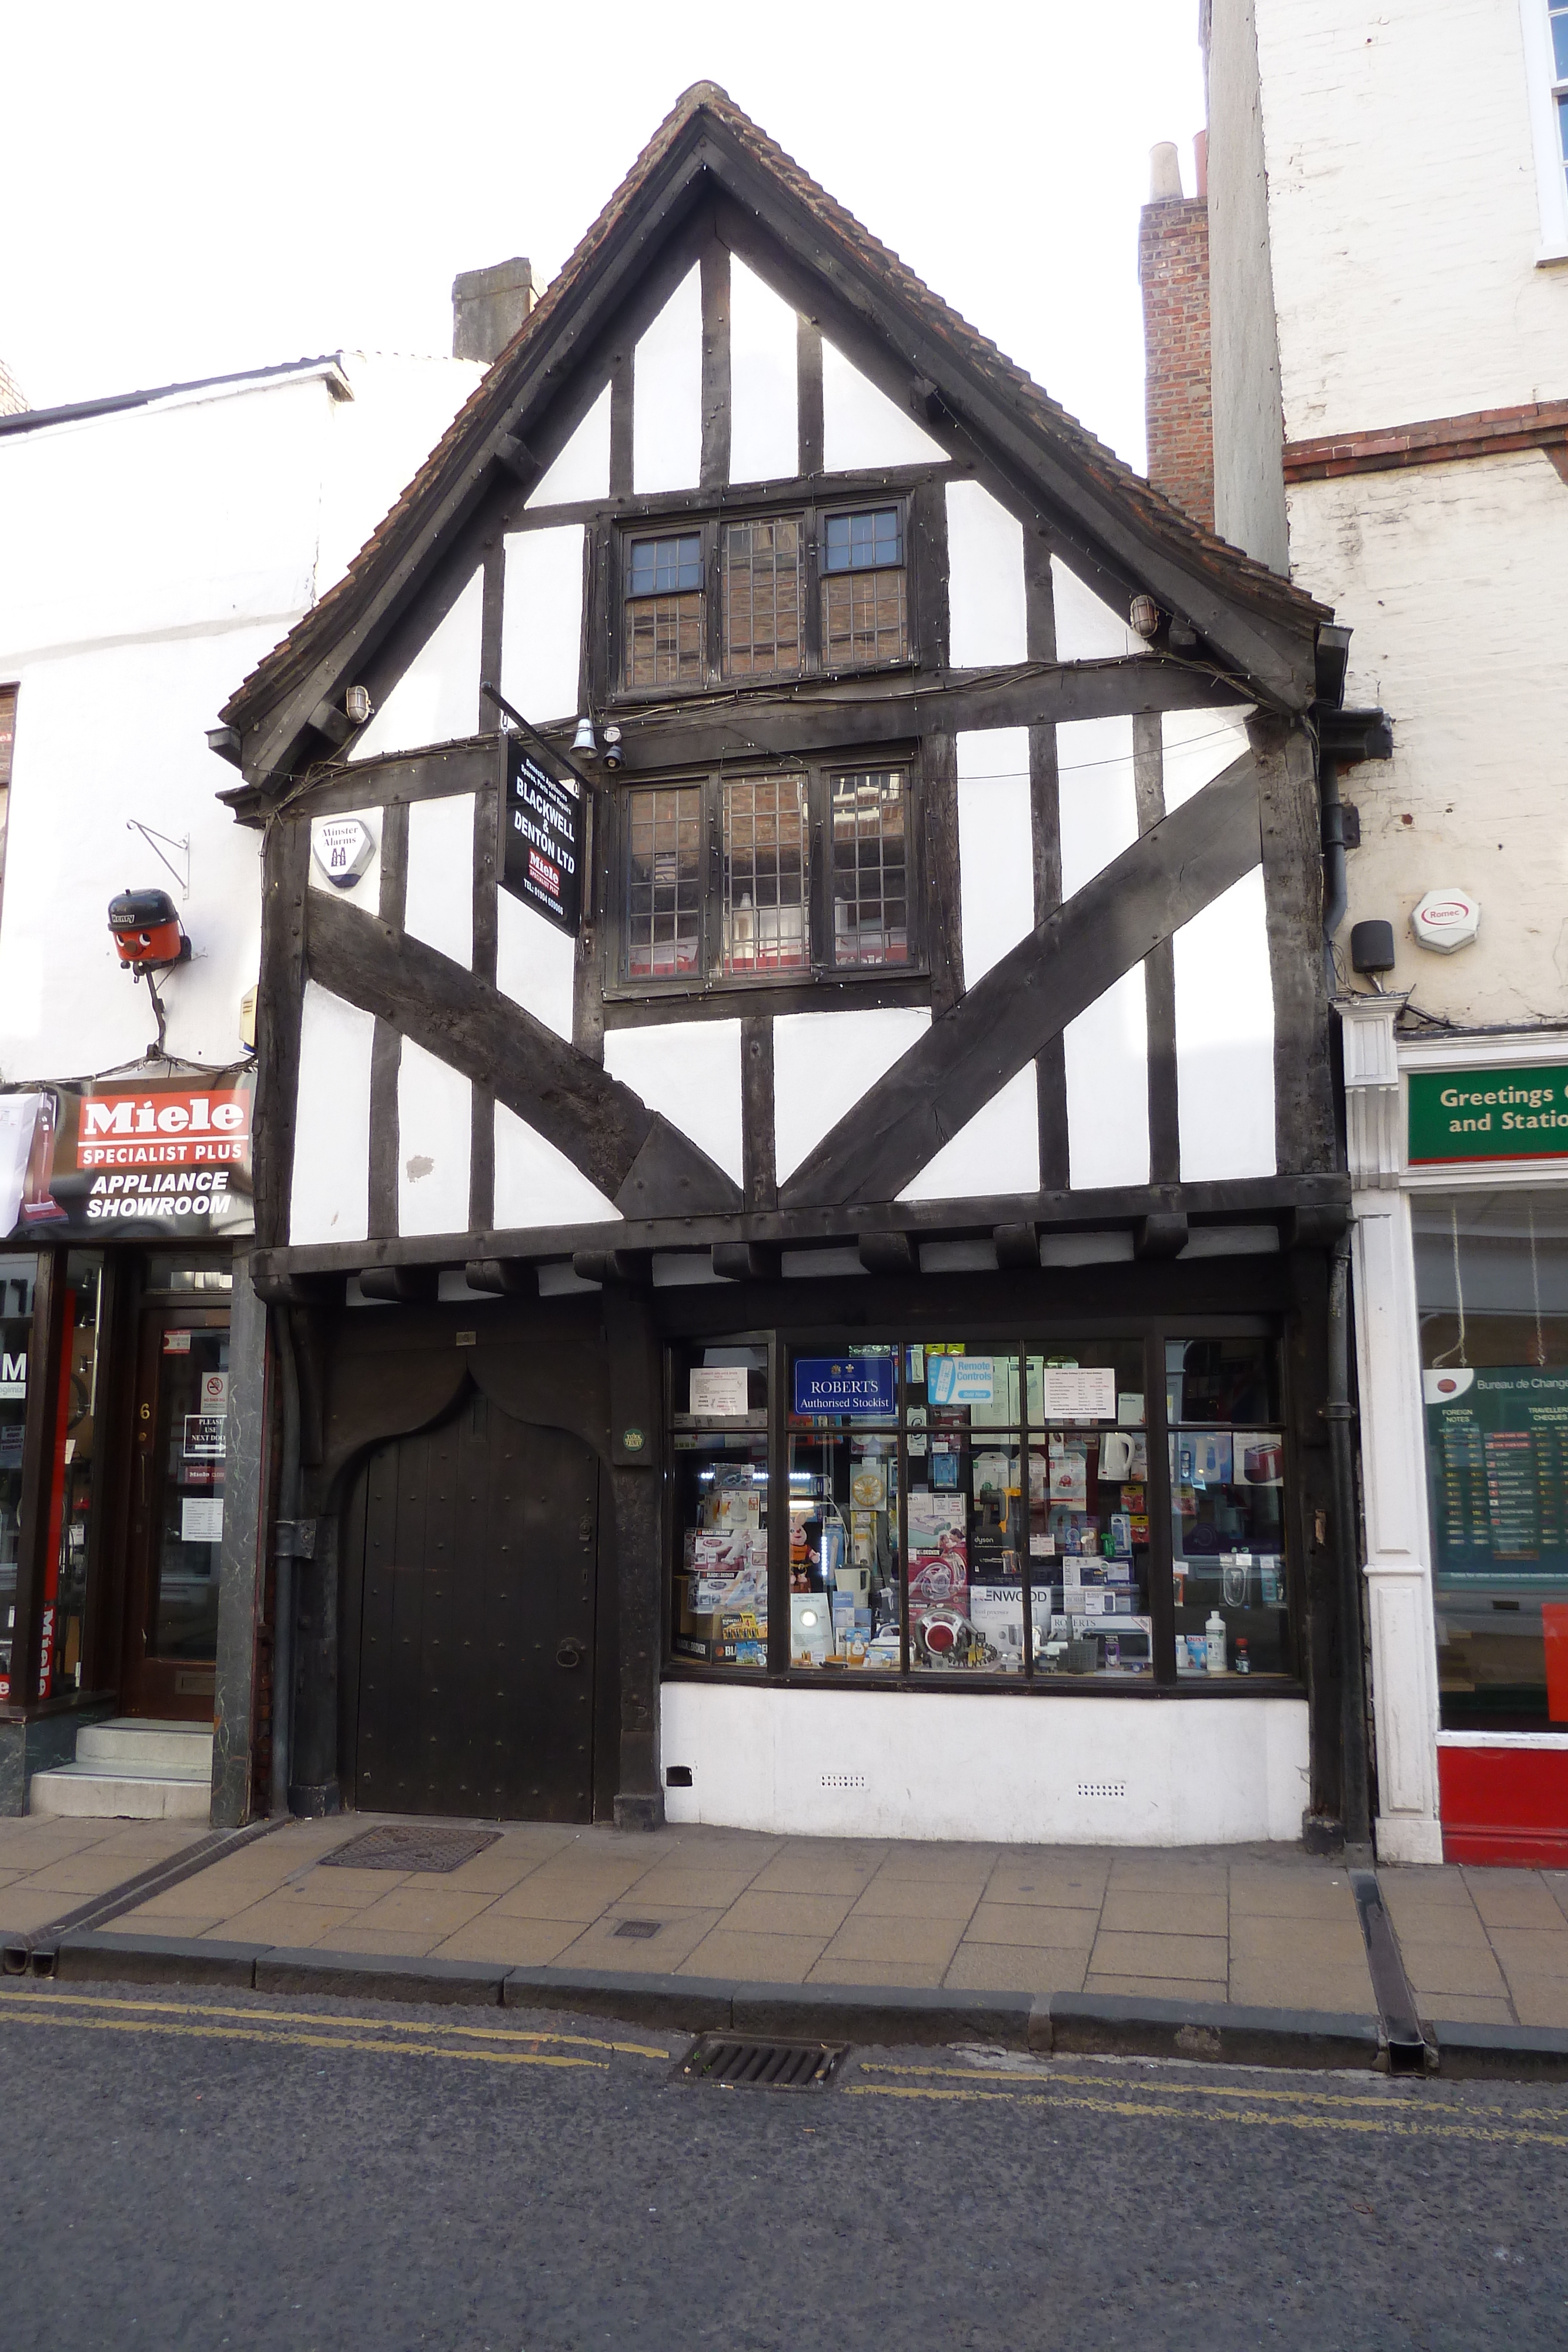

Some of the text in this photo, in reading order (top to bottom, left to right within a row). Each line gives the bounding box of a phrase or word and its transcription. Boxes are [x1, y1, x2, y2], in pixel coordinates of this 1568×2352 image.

[526, 759, 567, 802] Domestic Appliances
[537, 779, 549, 794] Parts
[557, 796, 571, 816] Repairs
[517, 776, 575, 843] BLACKWELL
[322, 828, 358, 837] Minster
[543, 818, 549, 834] &
[323, 837, 356, 847] Alarms
[514, 810, 575, 874] DENTON LTD
[530, 851, 559, 884] Miele
[524, 878, 534, 893] TEL:
[534, 887, 547, 904] 01904
[530, 869, 559, 896] SPECIALIST PLUS
[111, 914, 135, 923] Henry
[1440, 1085, 1553, 1108] Greetings
[84, 1098, 244, 1135] Miele
[1449, 1110, 1568, 1132] and Statio
[83, 1144, 242, 1165] SPECIALIST PLUS
[90, 1171, 229, 1194] APPLIANCE
[86, 1195, 231, 1217] SHOWROOM
[2, 1353, 26, 1380] M
[957, 1372, 991, 1381] Controls
[958, 1361, 990, 1370] Remote
[811, 1381, 878, 1393] ROBERTS
[1477, 1380, 1513, 1389] Bureau
[1516, 1379, 1529, 1388] de
[140, 1404, 150, 1419] 6
[800, 1398, 889, 1408] Authorised Stockist
[983, 1590, 1047, 1602] ENWOOD
[38, 1609, 53, 1696] Miele
